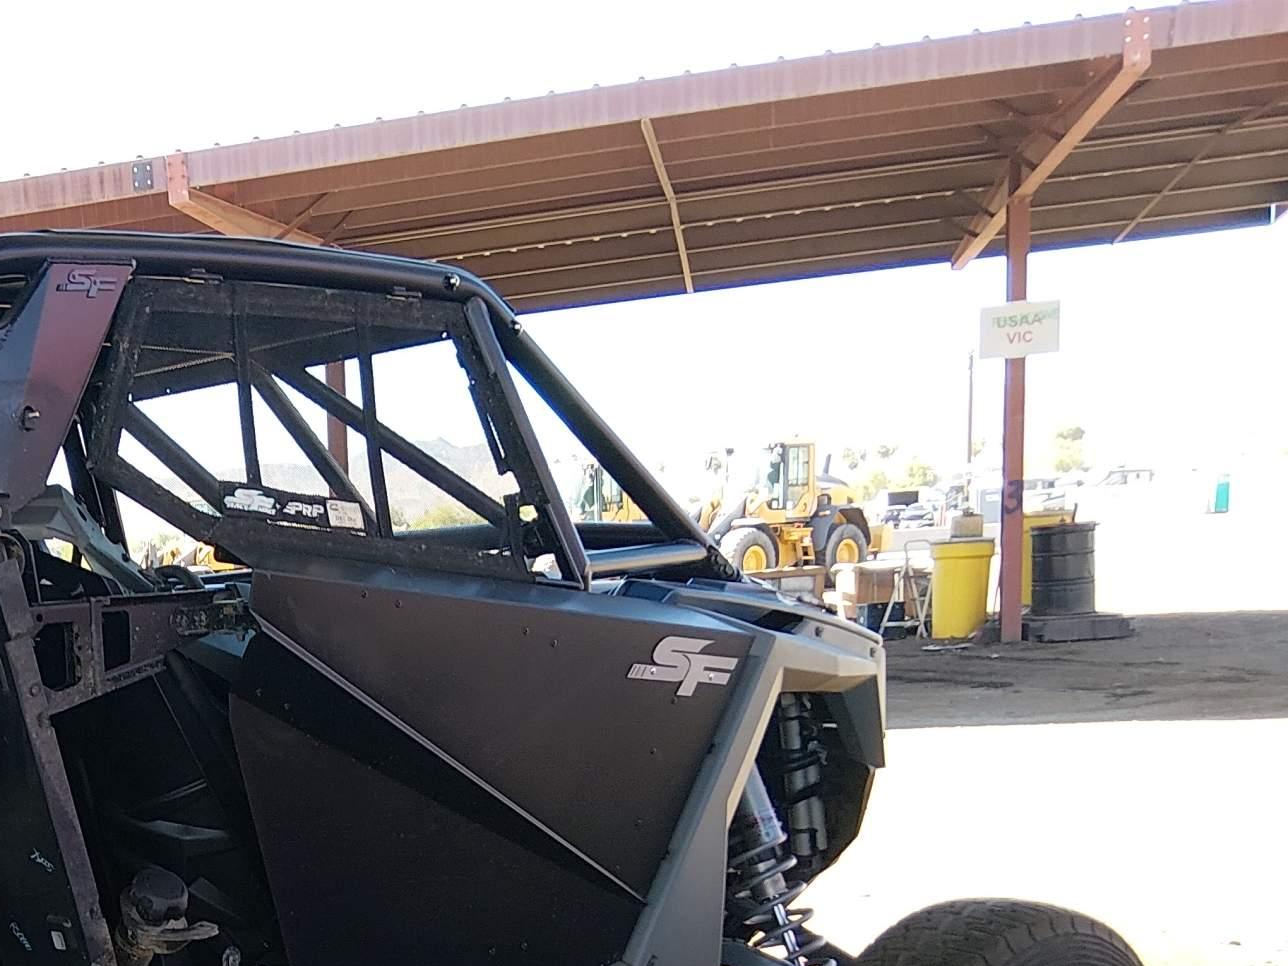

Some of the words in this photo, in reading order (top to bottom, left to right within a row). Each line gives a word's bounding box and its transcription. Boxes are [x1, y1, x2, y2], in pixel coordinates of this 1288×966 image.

[996, 313, 1043, 328] USAA
[1006, 330, 1033, 344] VIC
[627, 636, 739, 697] SF
